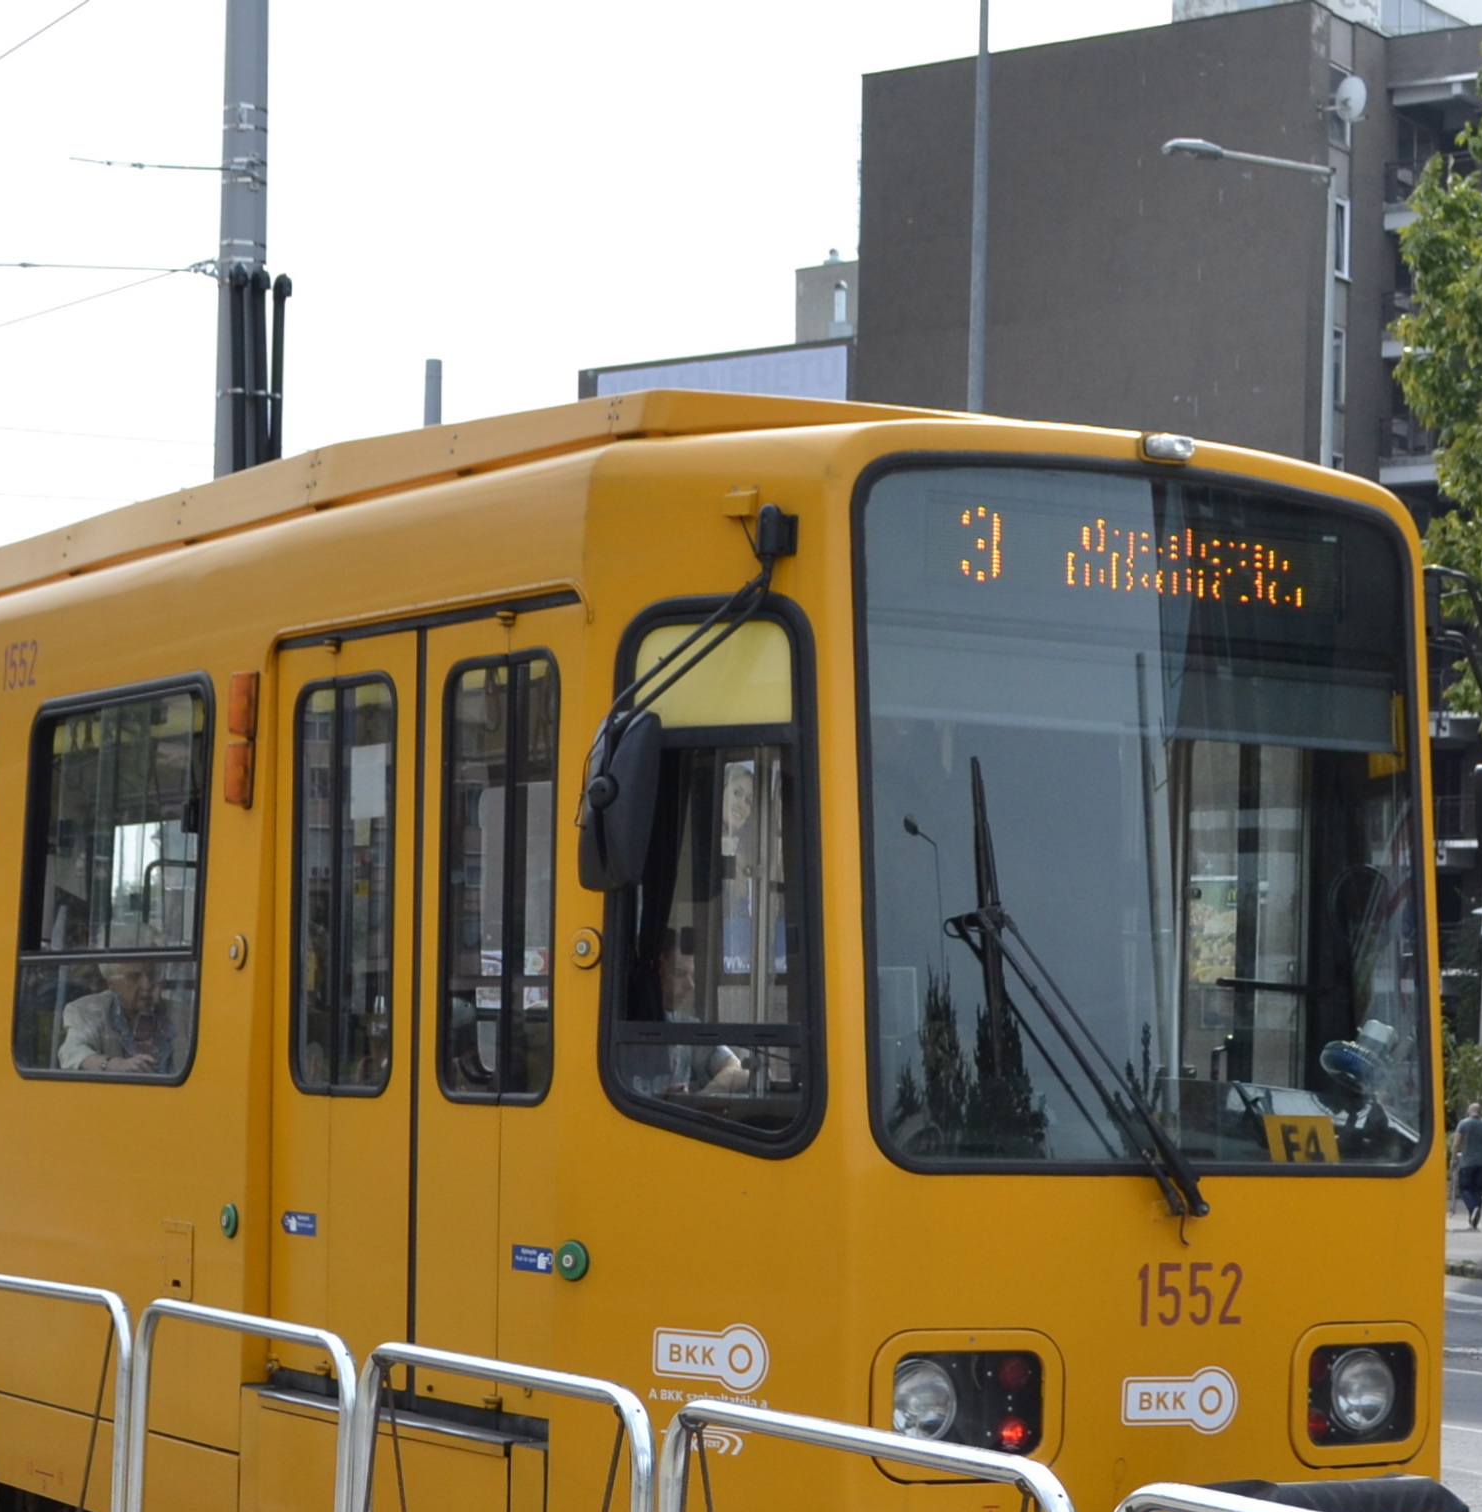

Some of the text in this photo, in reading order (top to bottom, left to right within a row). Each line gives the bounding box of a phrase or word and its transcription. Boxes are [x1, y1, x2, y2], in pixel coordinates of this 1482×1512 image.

[959, 505, 1003, 582] 3
[2, 640, 38, 691] 1552
[1137, 1261, 1244, 1327] 1552
[668, 1343, 716, 1366] BKK
[648, 1387, 658, 1400] A
[660, 1389, 683, 1402] BKK
[1137, 1391, 1188, 1413] BKK
